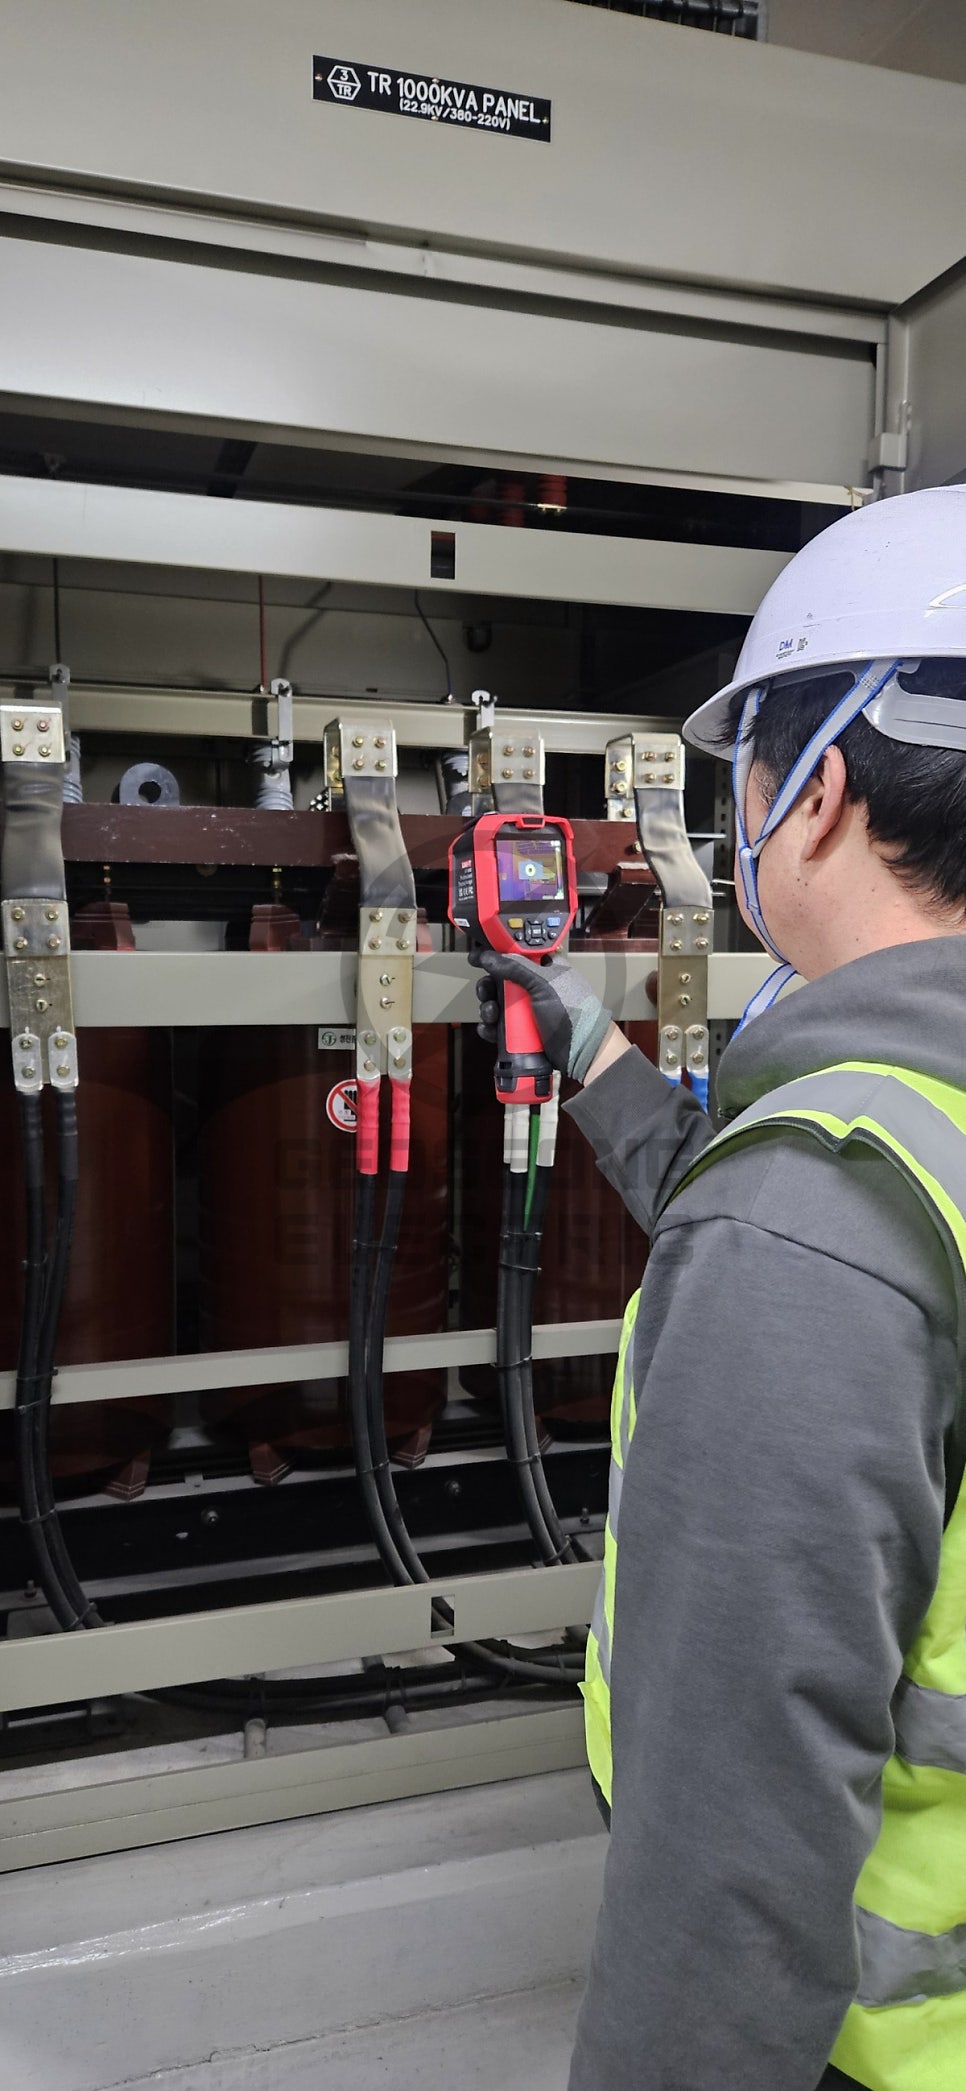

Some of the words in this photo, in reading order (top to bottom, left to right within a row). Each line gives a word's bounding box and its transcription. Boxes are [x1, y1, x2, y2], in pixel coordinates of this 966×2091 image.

[339, 69, 349, 82] 3
[336, 83, 352, 97] TR
[367, 71, 391, 95] TR
[396, 77, 478, 112] 1000KVA
[483, 93, 541, 124] PANEL
[399, 98, 511, 131] (22.9KV/380-220V)
